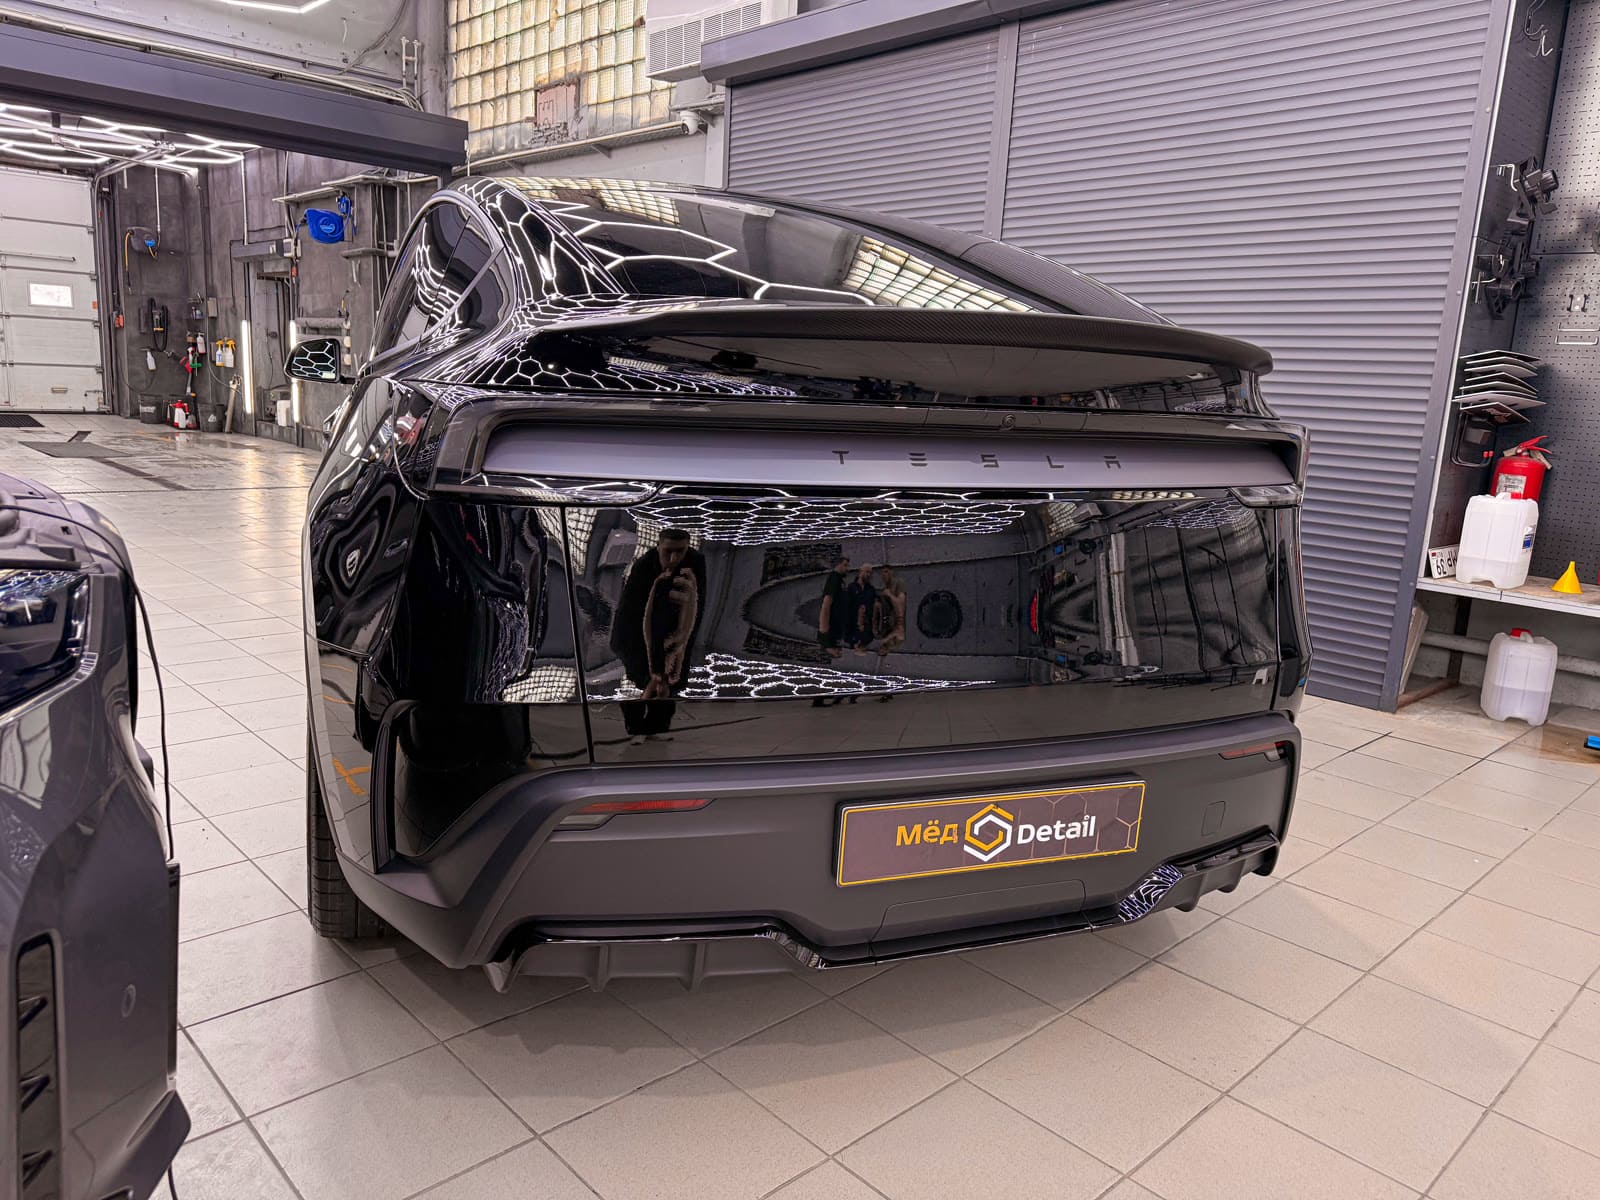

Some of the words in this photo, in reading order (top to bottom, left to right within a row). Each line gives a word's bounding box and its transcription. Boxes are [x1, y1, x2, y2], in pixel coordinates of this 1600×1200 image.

[832, 450, 1121, 469] TESLA
[896, 820, 958, 847] Мёд
[1017, 815, 1096, 845] Detail
